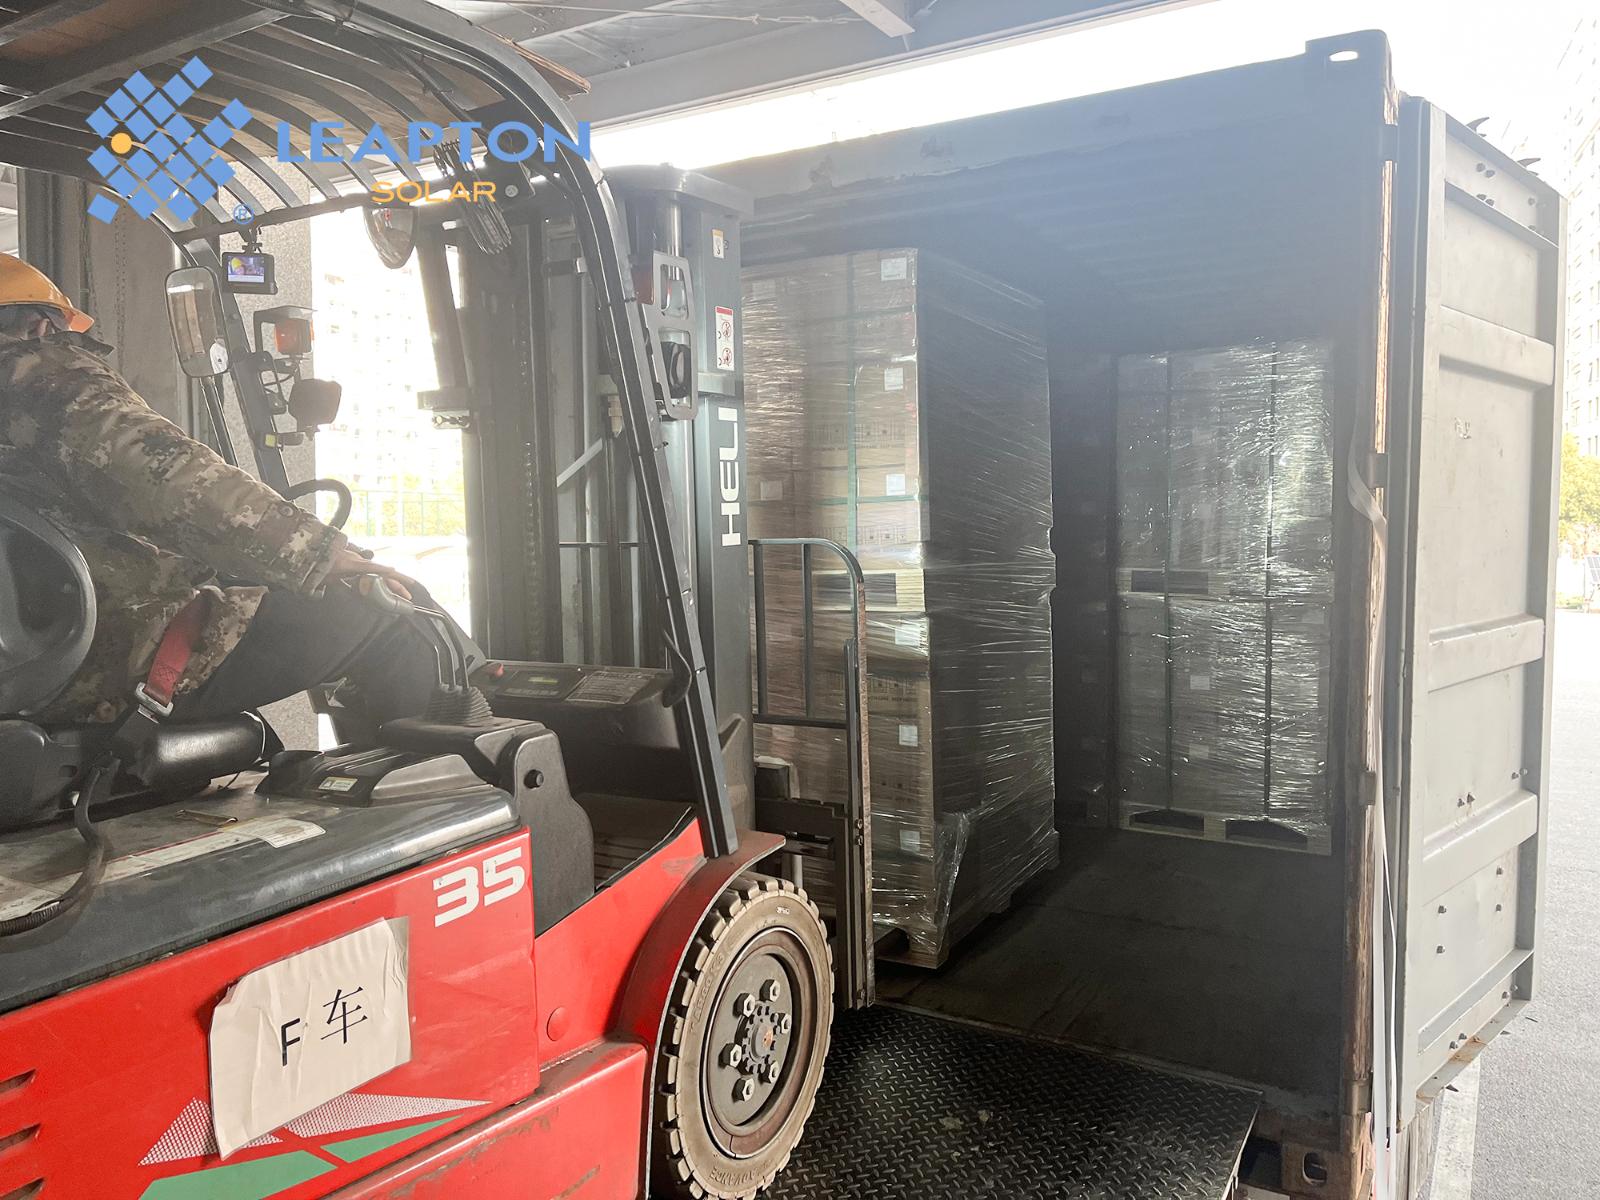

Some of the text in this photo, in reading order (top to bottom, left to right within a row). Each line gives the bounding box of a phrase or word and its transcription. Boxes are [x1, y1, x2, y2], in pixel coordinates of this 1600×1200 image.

[718, 406, 741, 546] HELI
[433, 846, 525, 927] 35
[281, 986, 369, 1066] F 车
